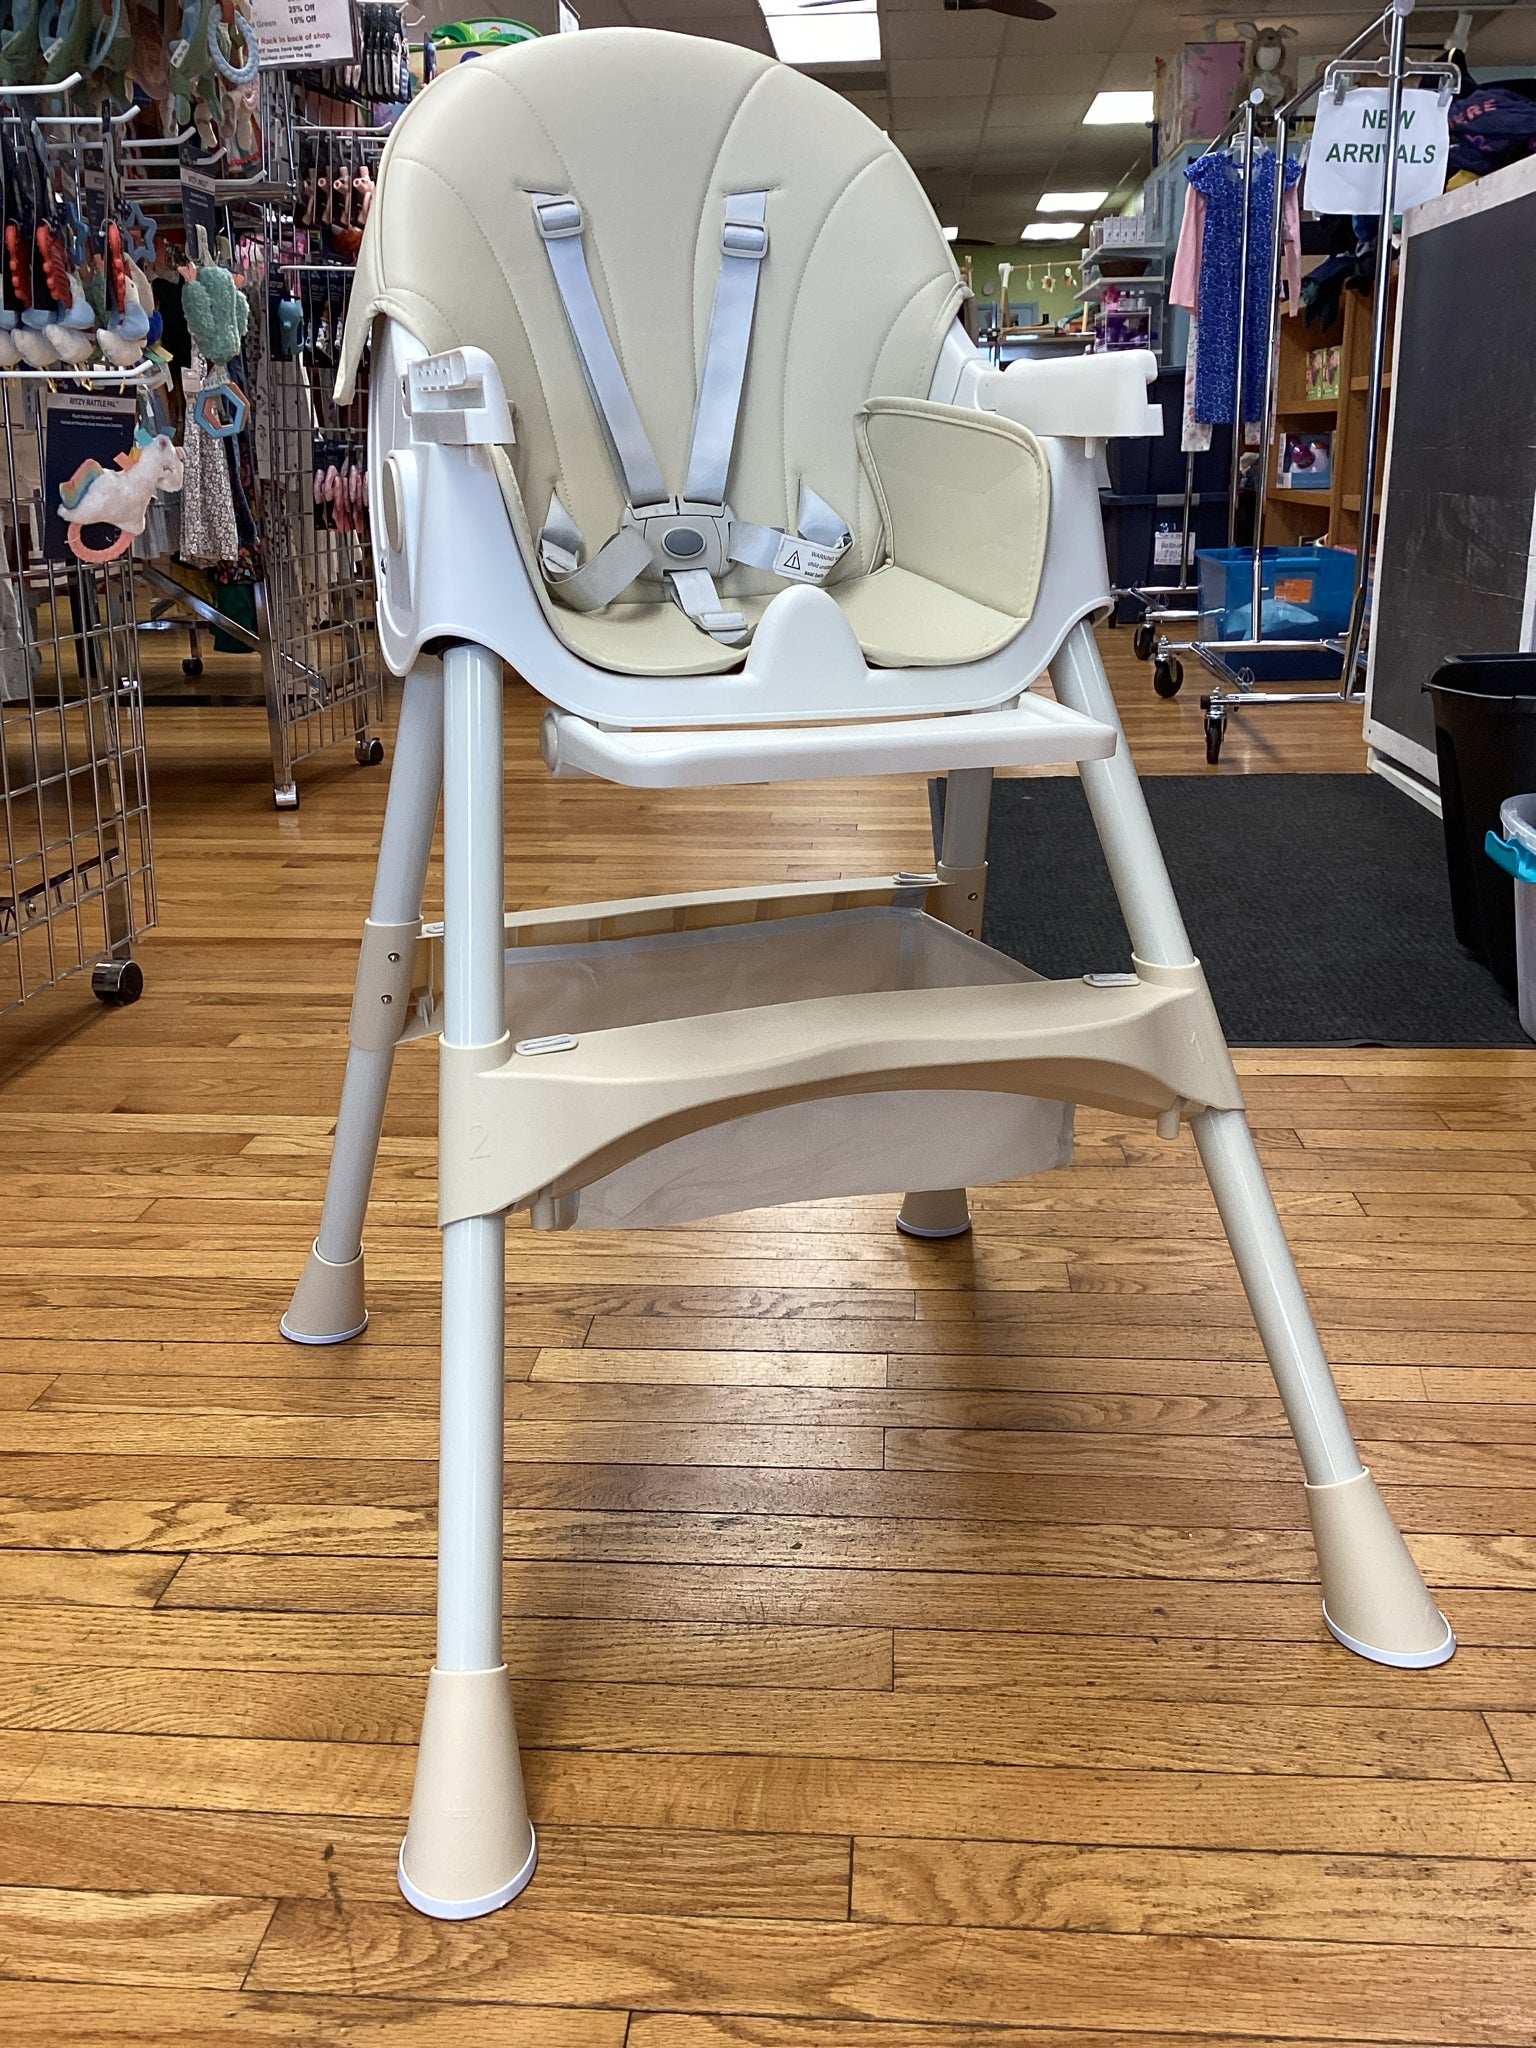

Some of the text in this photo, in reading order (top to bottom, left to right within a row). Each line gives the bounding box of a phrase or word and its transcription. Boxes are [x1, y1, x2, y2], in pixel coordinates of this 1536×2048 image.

[288, 4, 315, 14] 25% Off
[290, 15, 317, 25] 15% Off
[280, 35, 286, 43] in
[287, 33, 302, 42] back
[305, 32, 312, 40] of
[1362, 109, 1416, 129] NEW
[1325, 143, 1436, 164] ARRIALS
[467, 1121, 492, 1161] 2
